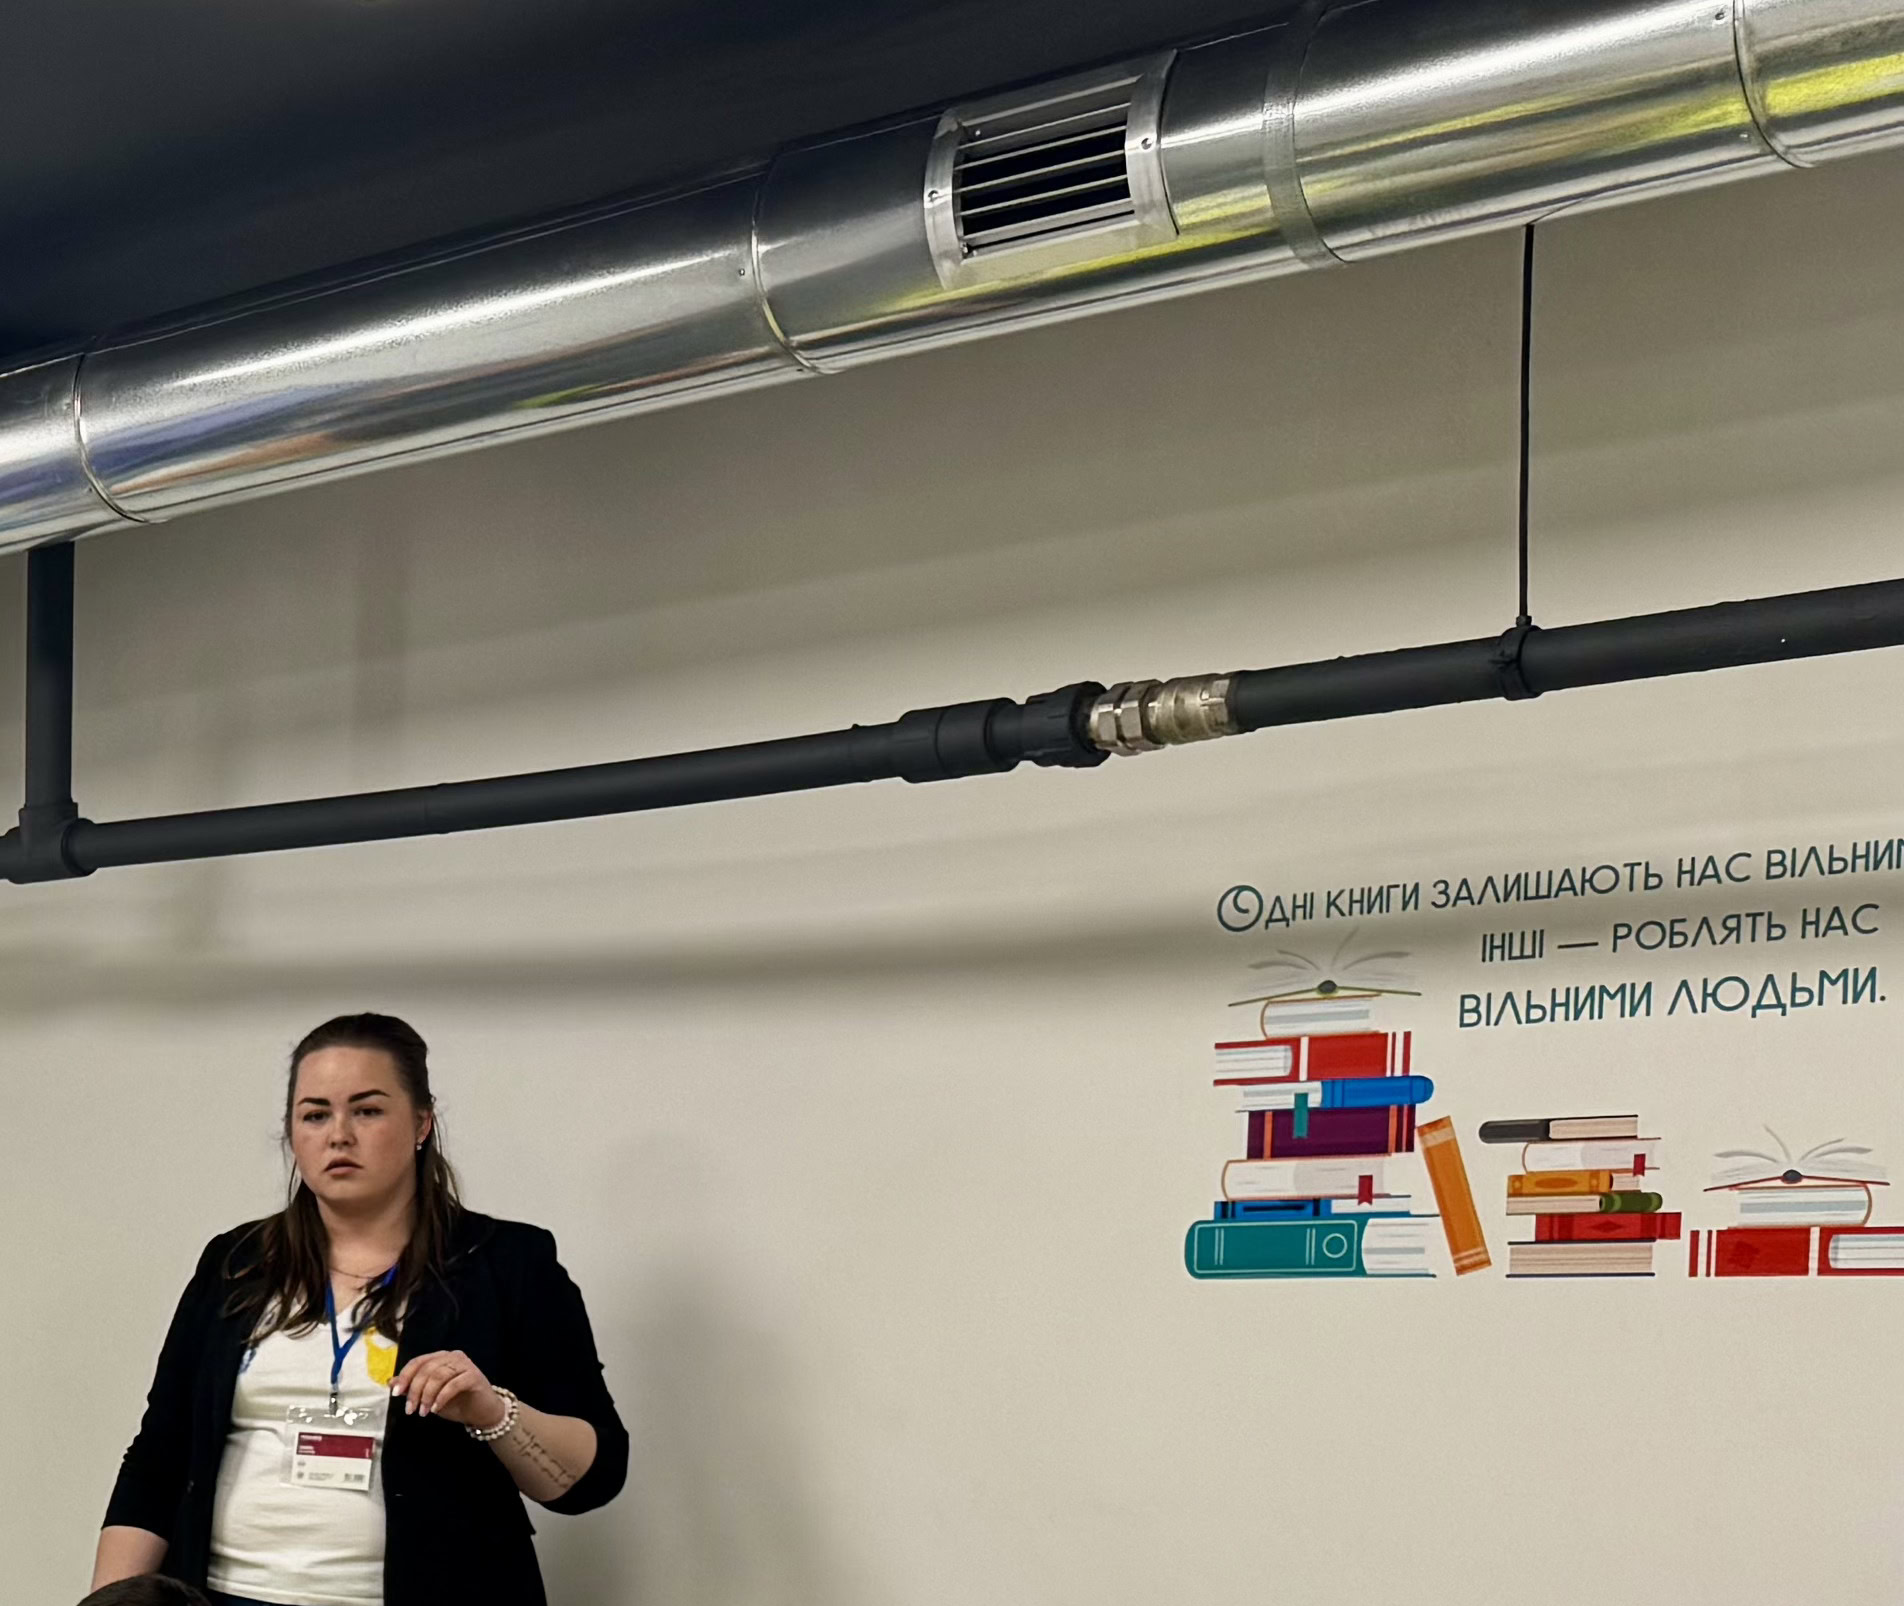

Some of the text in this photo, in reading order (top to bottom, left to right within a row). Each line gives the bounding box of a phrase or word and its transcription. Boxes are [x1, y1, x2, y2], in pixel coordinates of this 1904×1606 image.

[1326, 881, 1420, 919] КНИГИ
[1430, 860, 1663, 909] ЗАЛИШАЮТЬ
[1676, 852, 1752, 889] НАС
[1481, 929, 1545, 963] ІНШІ
[1611, 911, 1786, 953] РОБЛЯТЬ
[1800, 903, 1880, 940] НАС
[1459, 966, 1887, 1029] ВІЛЬНИМИ ЛЮДЬМИ.
